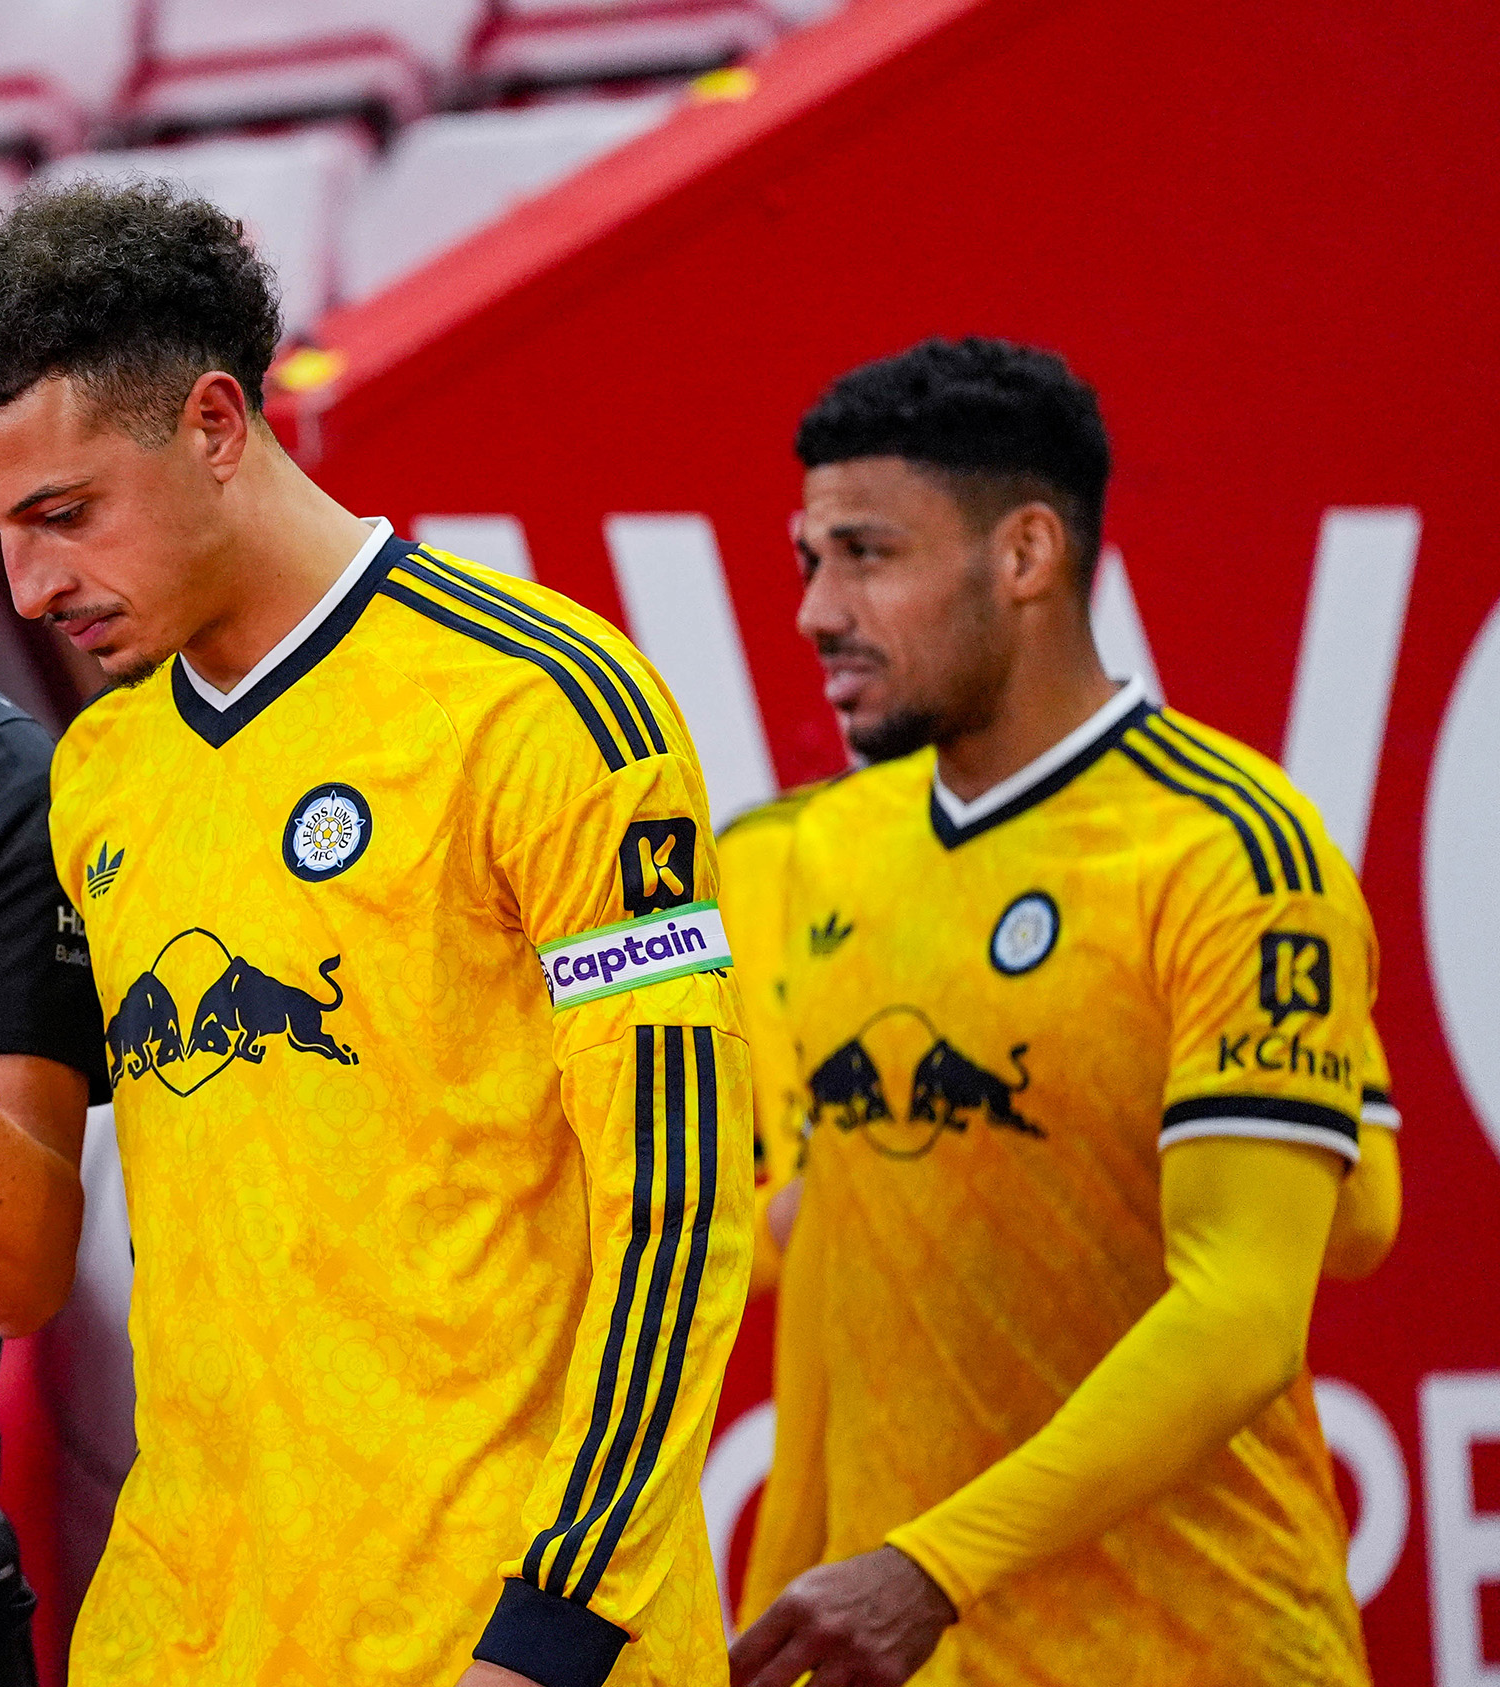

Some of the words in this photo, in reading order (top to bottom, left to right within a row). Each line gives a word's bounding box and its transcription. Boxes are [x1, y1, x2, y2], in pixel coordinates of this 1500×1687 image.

[303, 807, 328, 847] LEEDS
[334, 807, 353, 848] UNITED
[310, 850, 333, 861] AFC
[638, 833, 684, 897] K
[553, 922, 707, 987] Captain
